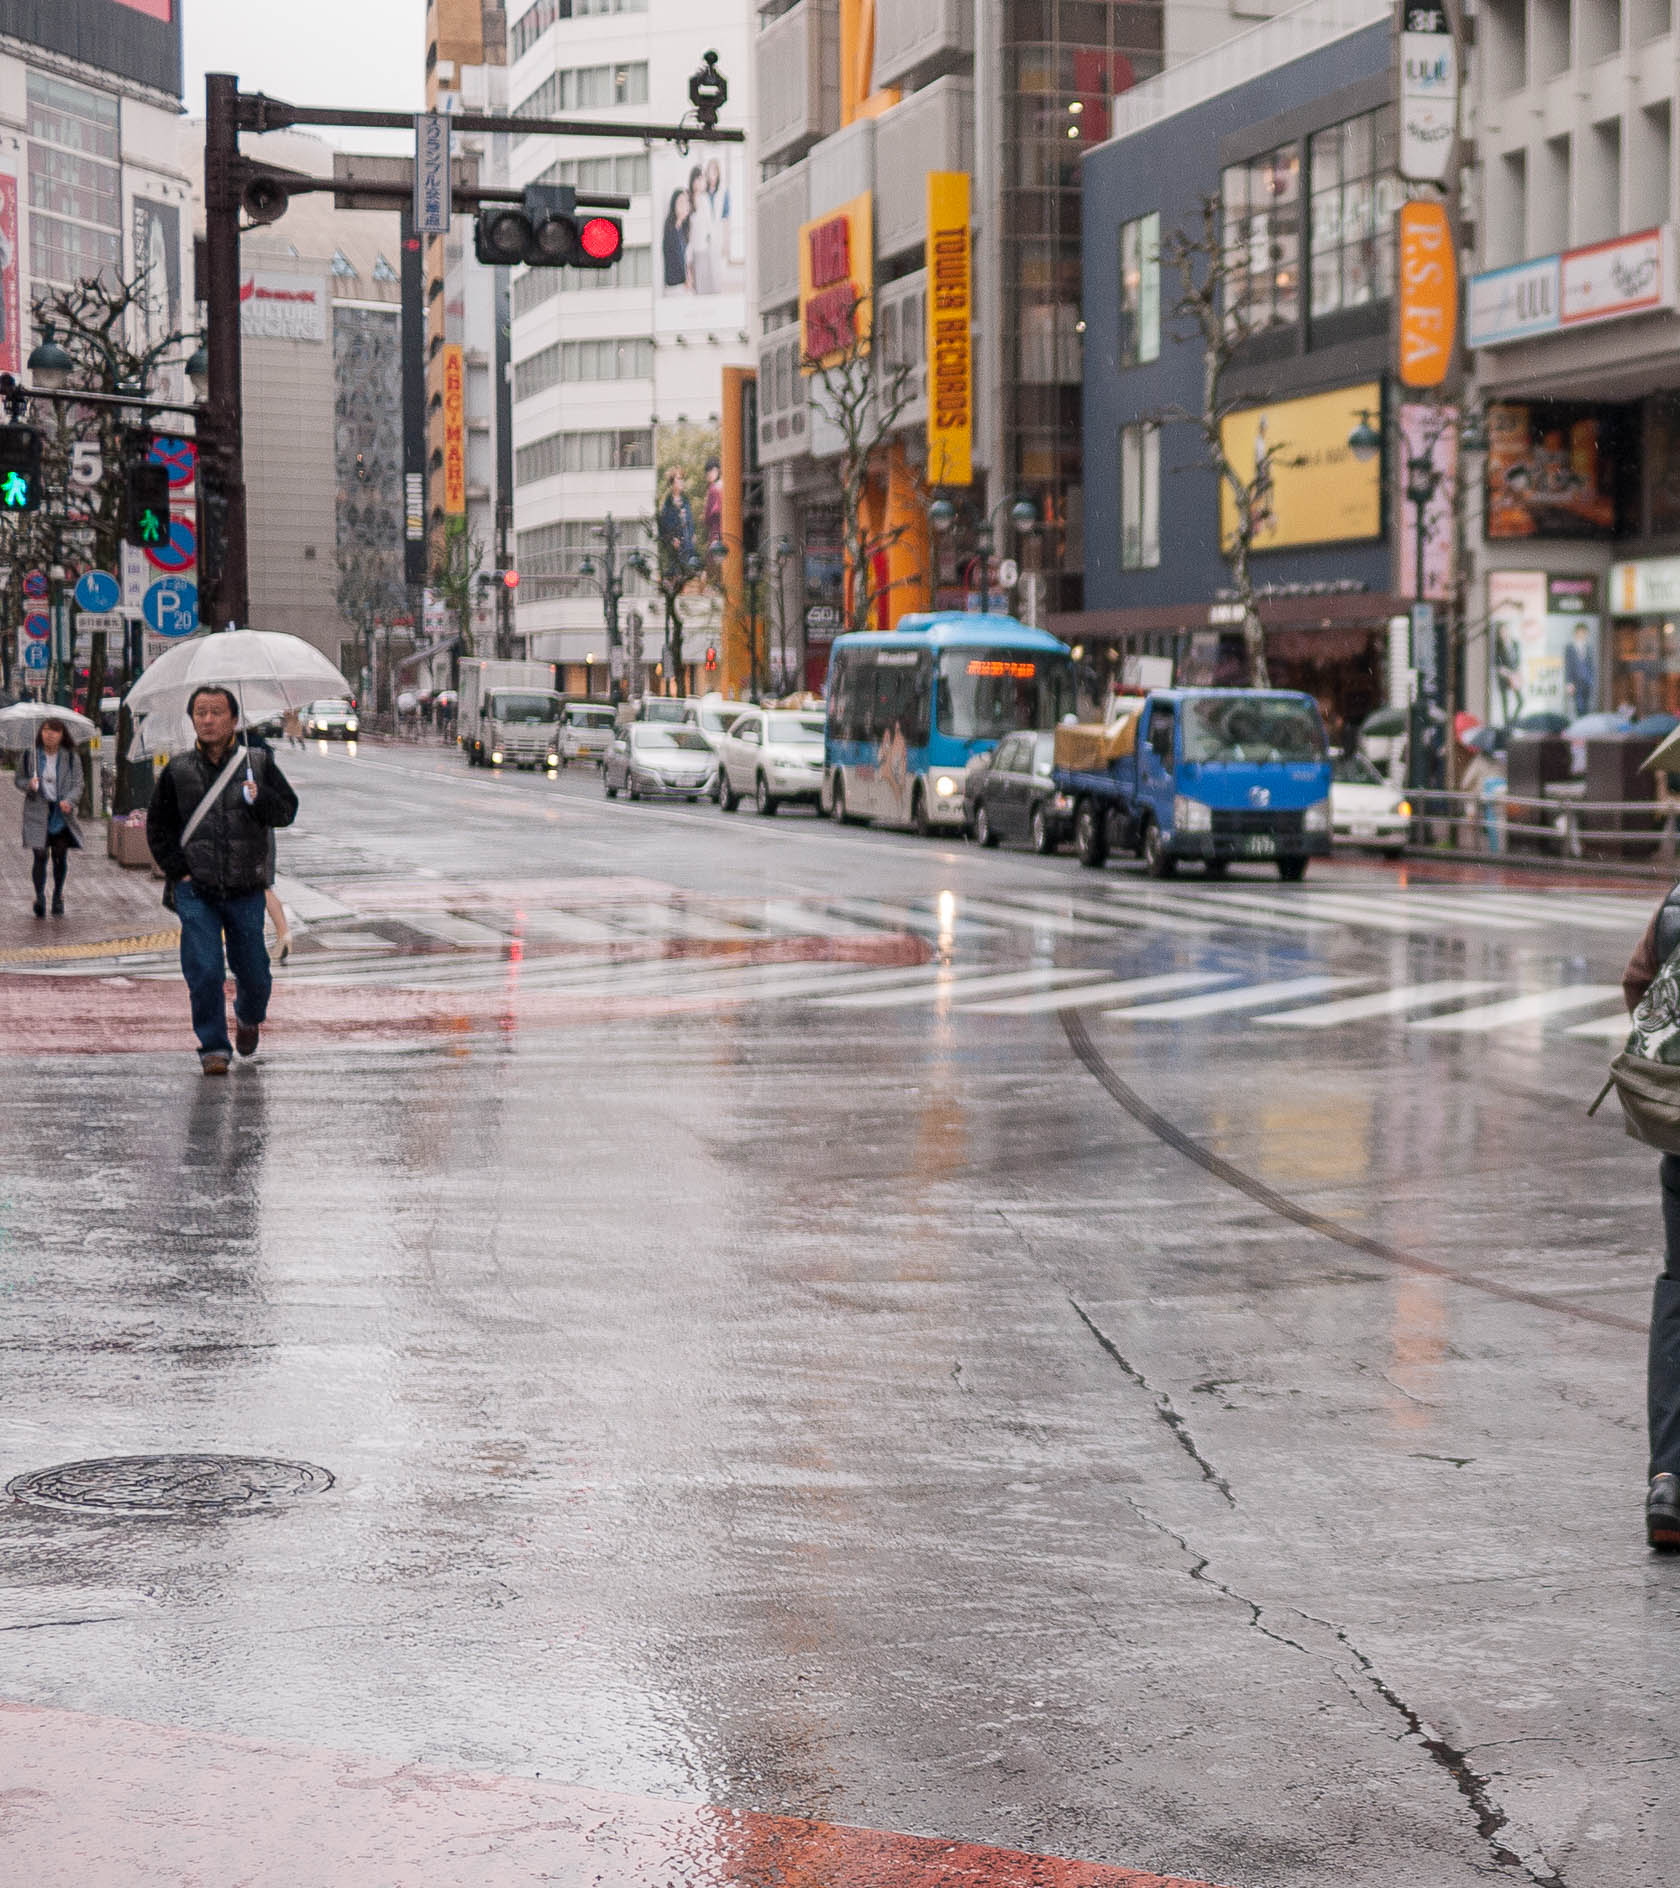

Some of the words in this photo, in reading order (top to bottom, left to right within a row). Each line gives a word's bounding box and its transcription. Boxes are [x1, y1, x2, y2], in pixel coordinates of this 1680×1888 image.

[936, 226, 968, 310] TOWER
[936, 315, 970, 429] RECORDS
[71, 441, 103, 486] 5
[158, 590, 180, 629] P
[174, 611, 192, 630] 20
